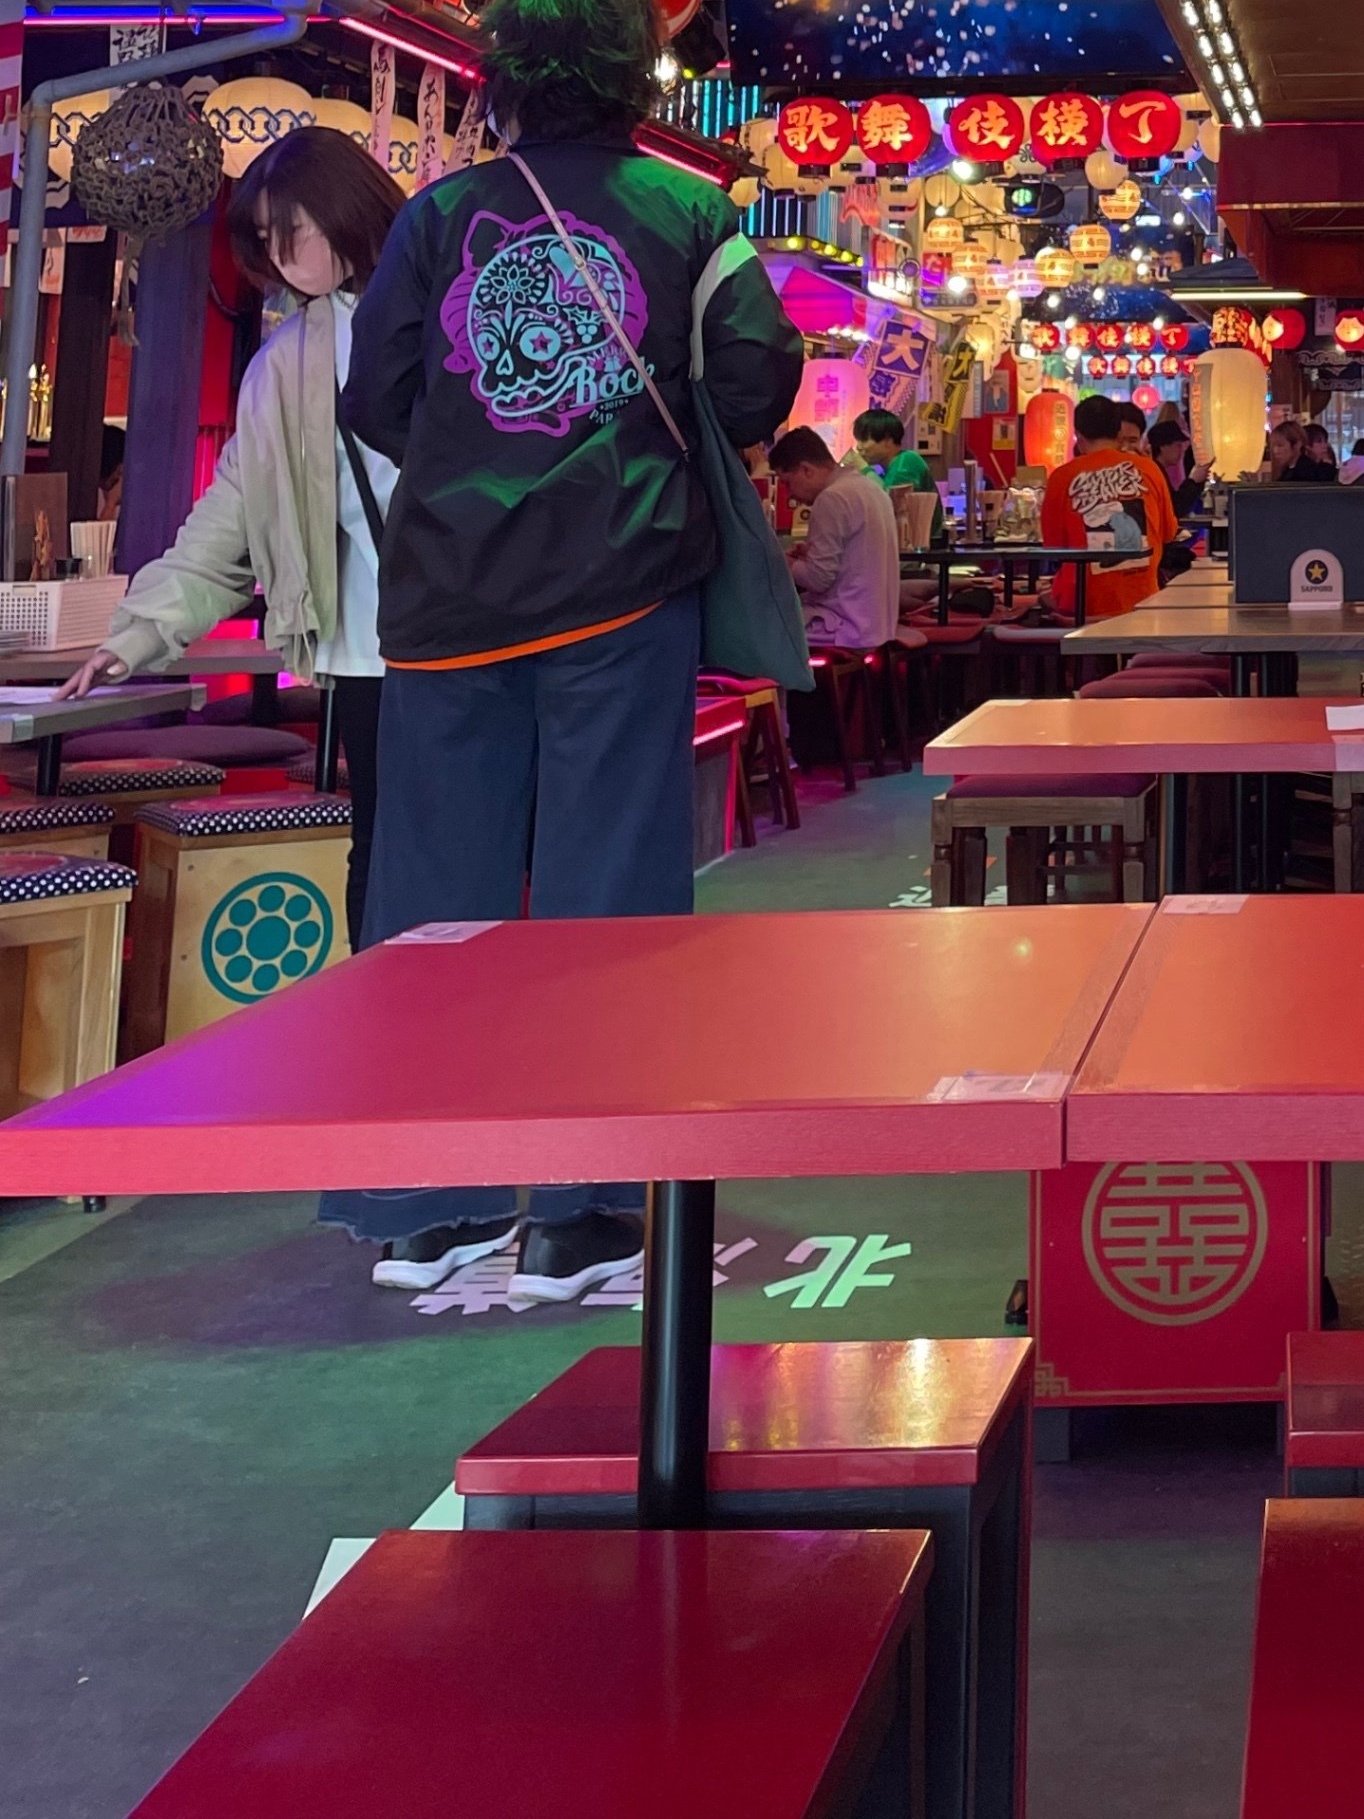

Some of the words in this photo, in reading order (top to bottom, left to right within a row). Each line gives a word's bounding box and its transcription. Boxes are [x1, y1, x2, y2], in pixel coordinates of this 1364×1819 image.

[785, 99, 1168, 154] 歌舞伎横丁
